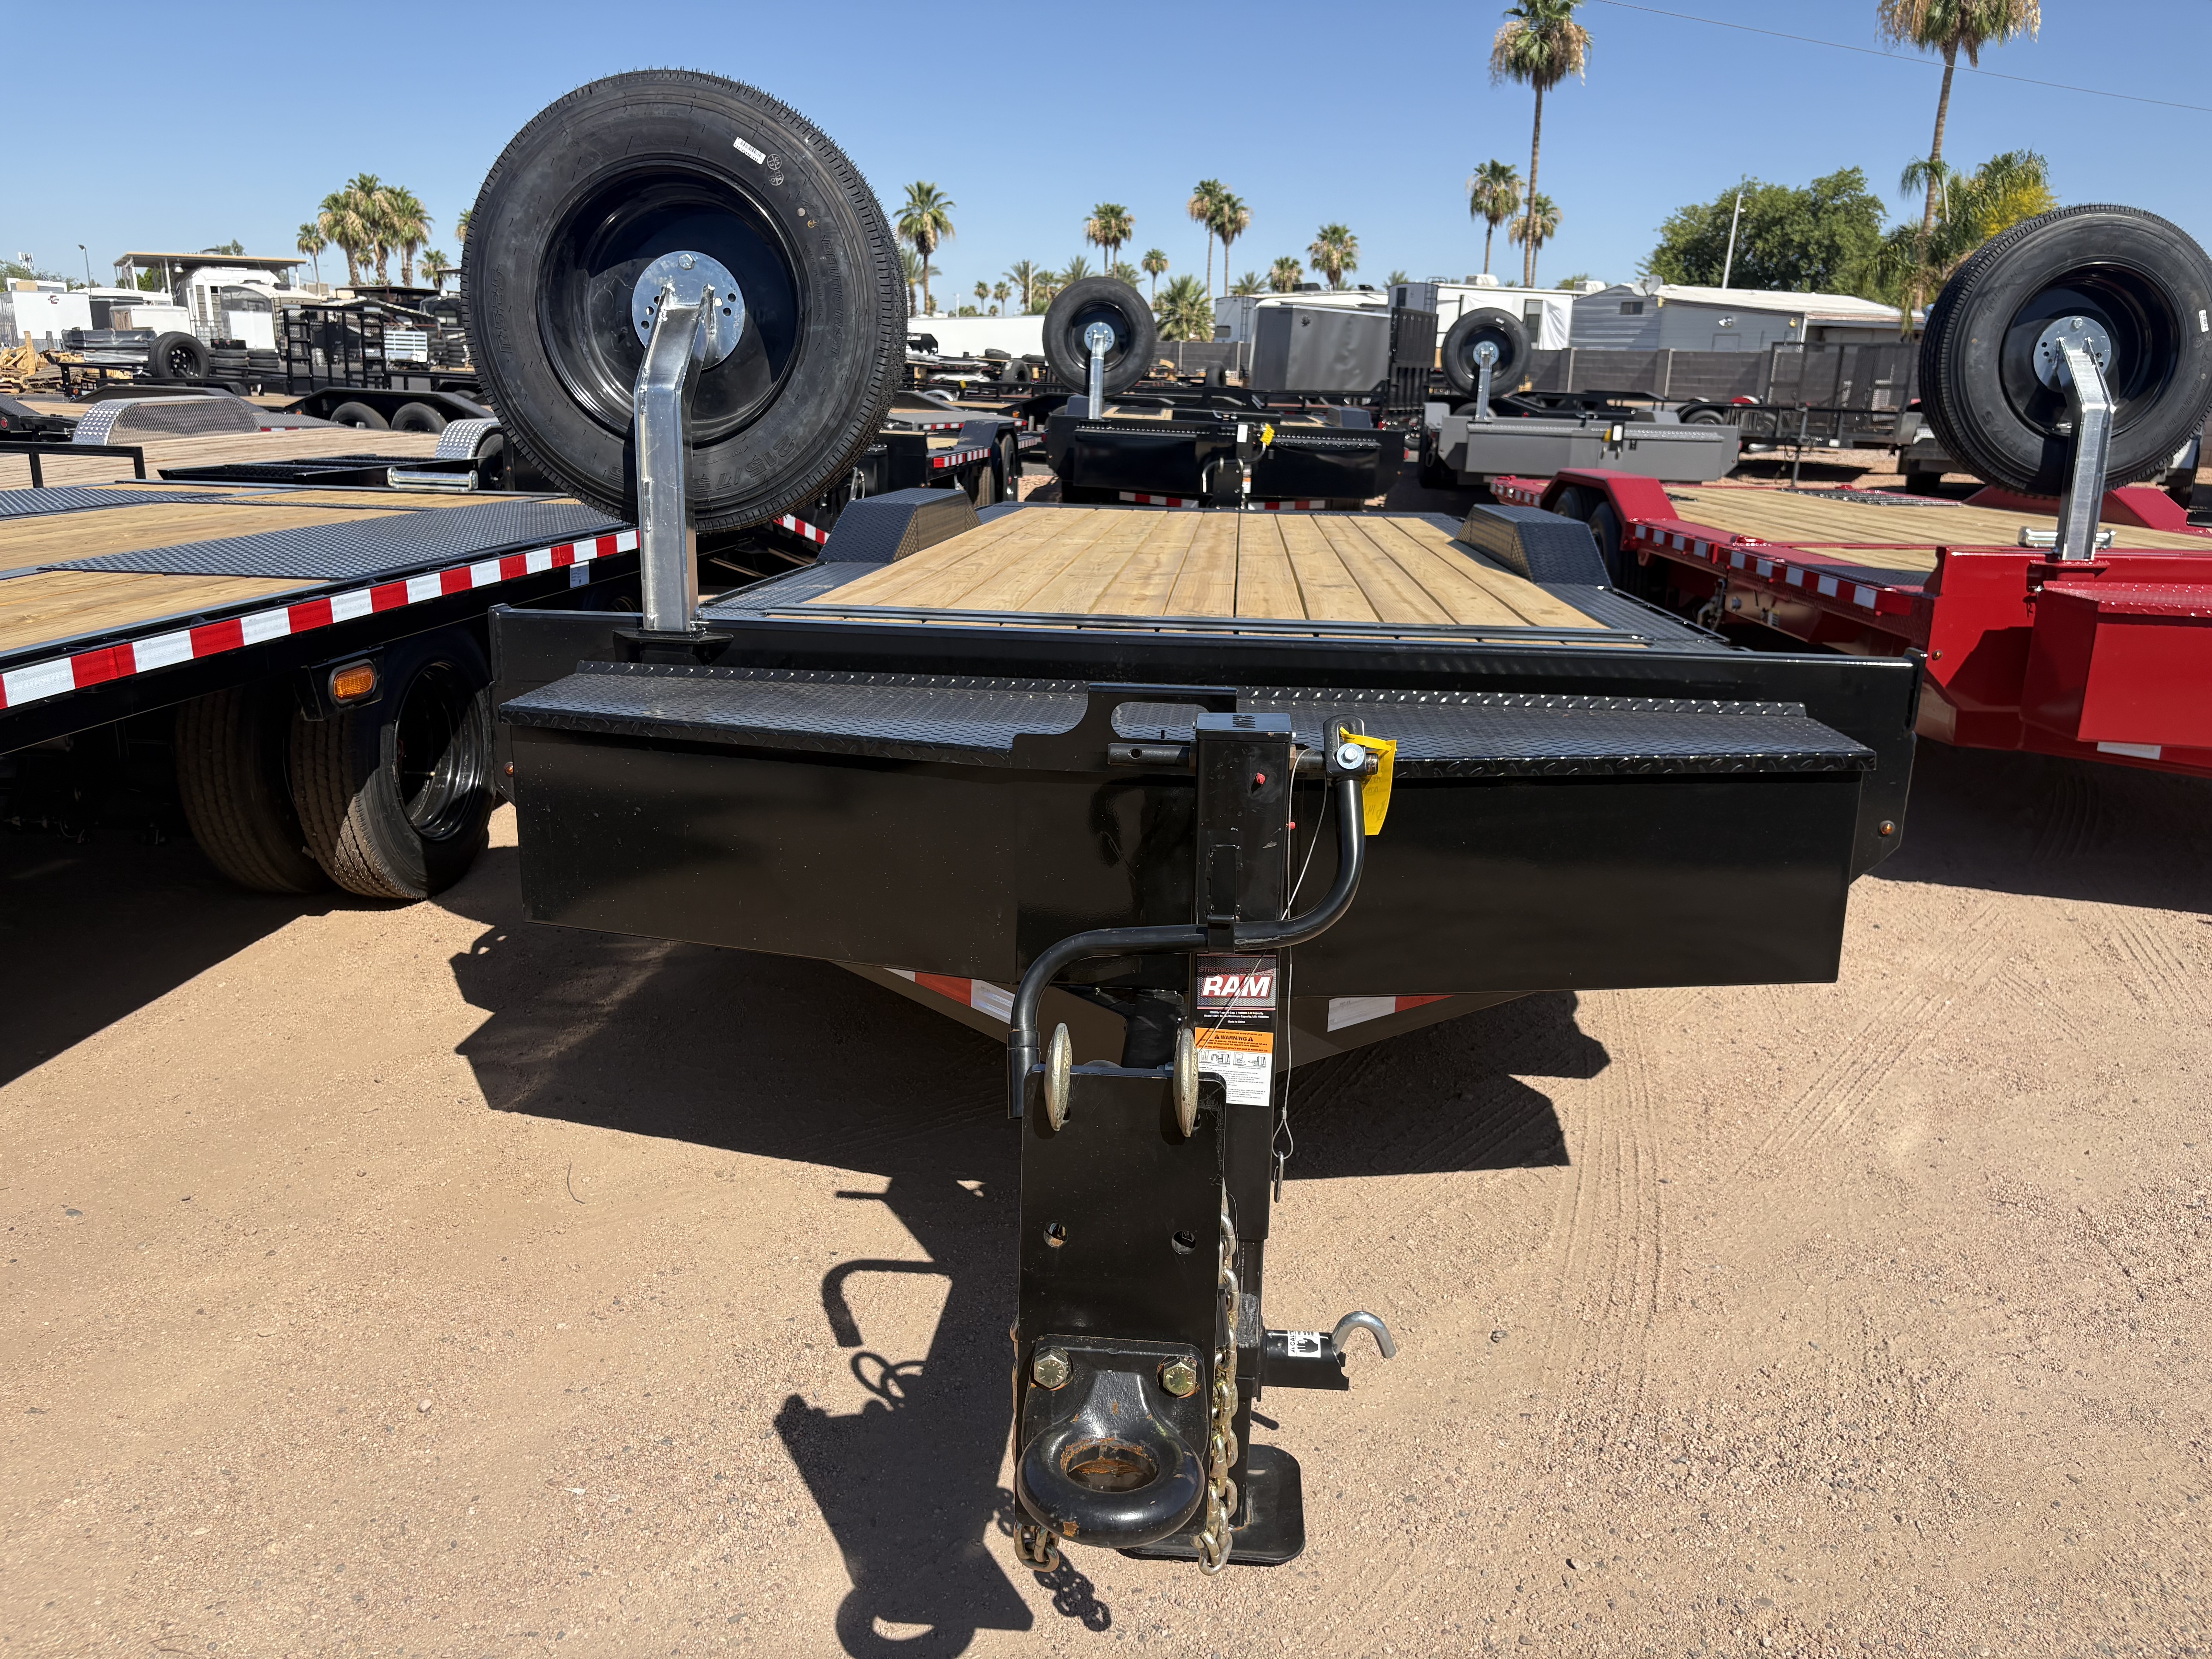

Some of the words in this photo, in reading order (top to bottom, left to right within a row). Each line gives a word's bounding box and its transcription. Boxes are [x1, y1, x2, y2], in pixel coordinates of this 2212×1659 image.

[815, 279, 824, 312] THAILAND
[693, 435, 795, 494] 215/75
[1202, 975, 1271, 997] RAM
